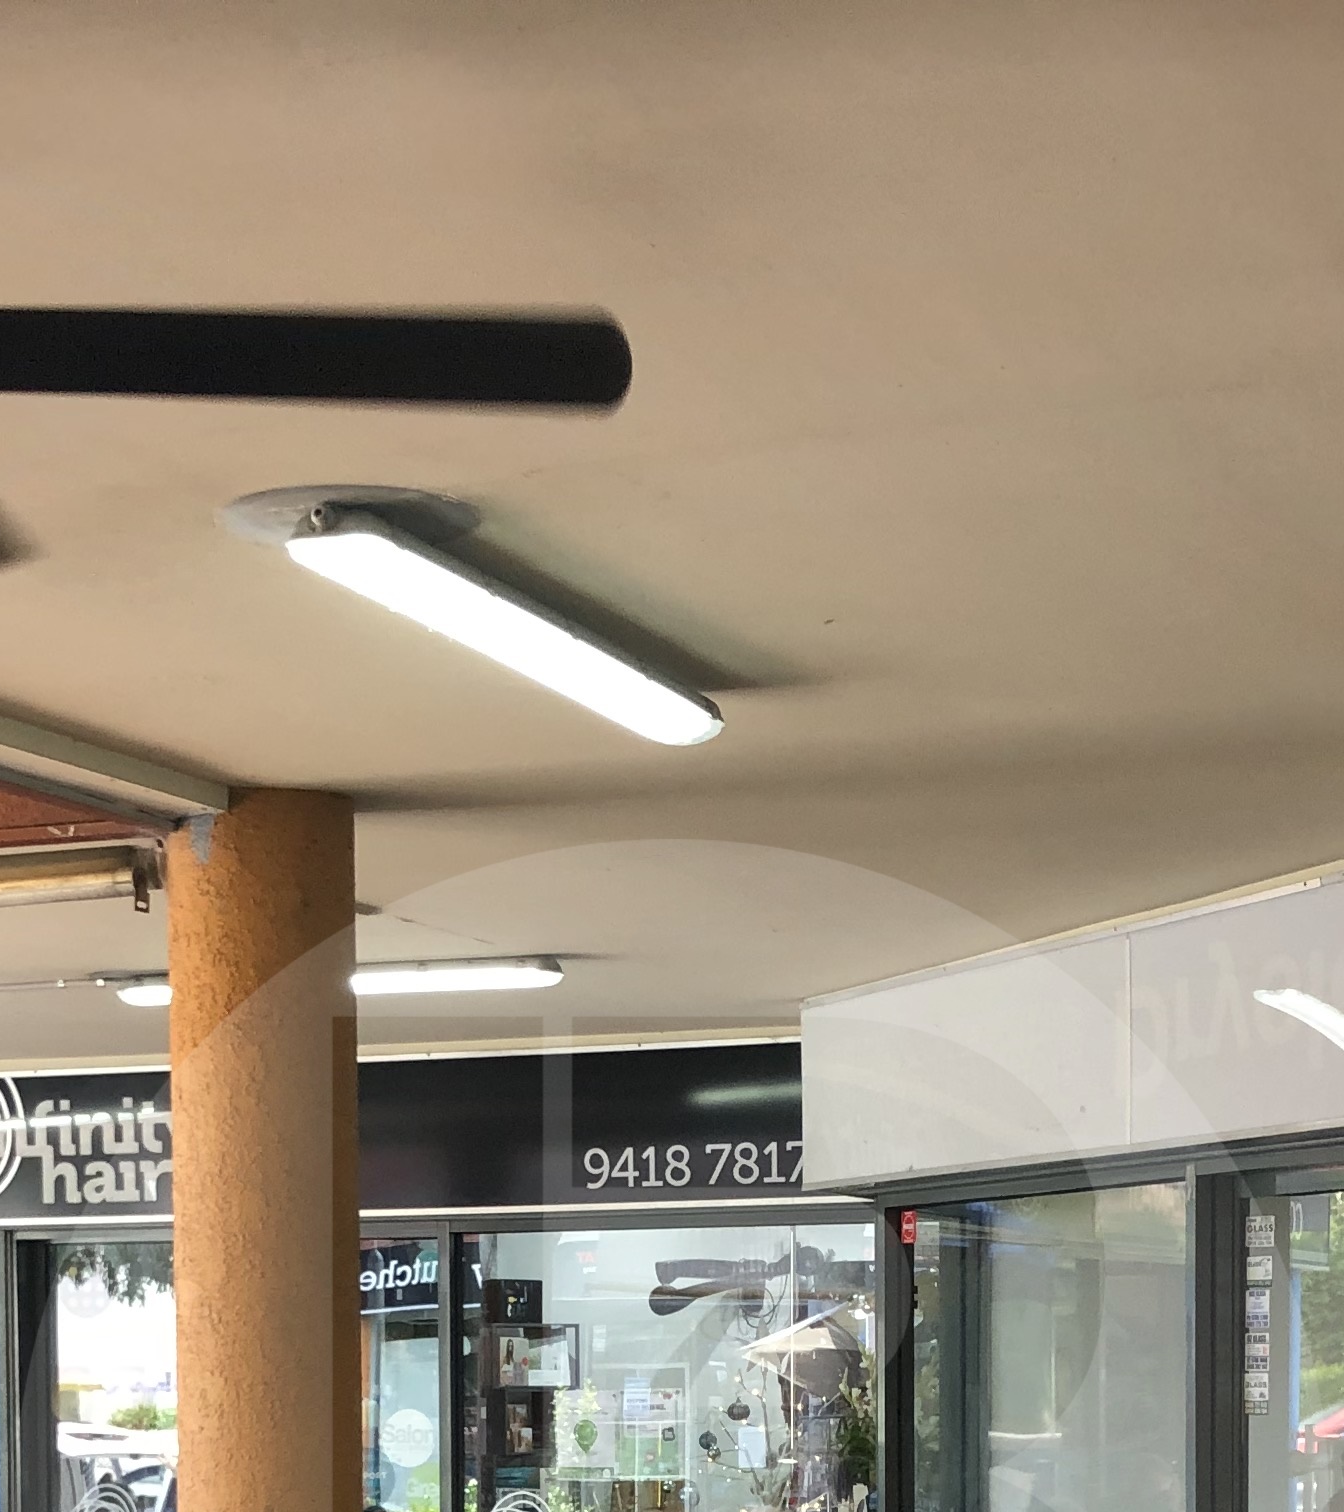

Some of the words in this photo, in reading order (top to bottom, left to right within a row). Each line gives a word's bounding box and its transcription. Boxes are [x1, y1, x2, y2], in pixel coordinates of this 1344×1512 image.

[41, 1148, 174, 1205] hair
[583, 1144, 691, 1190] 9418
[705, 1141, 803, 1185] 7817
